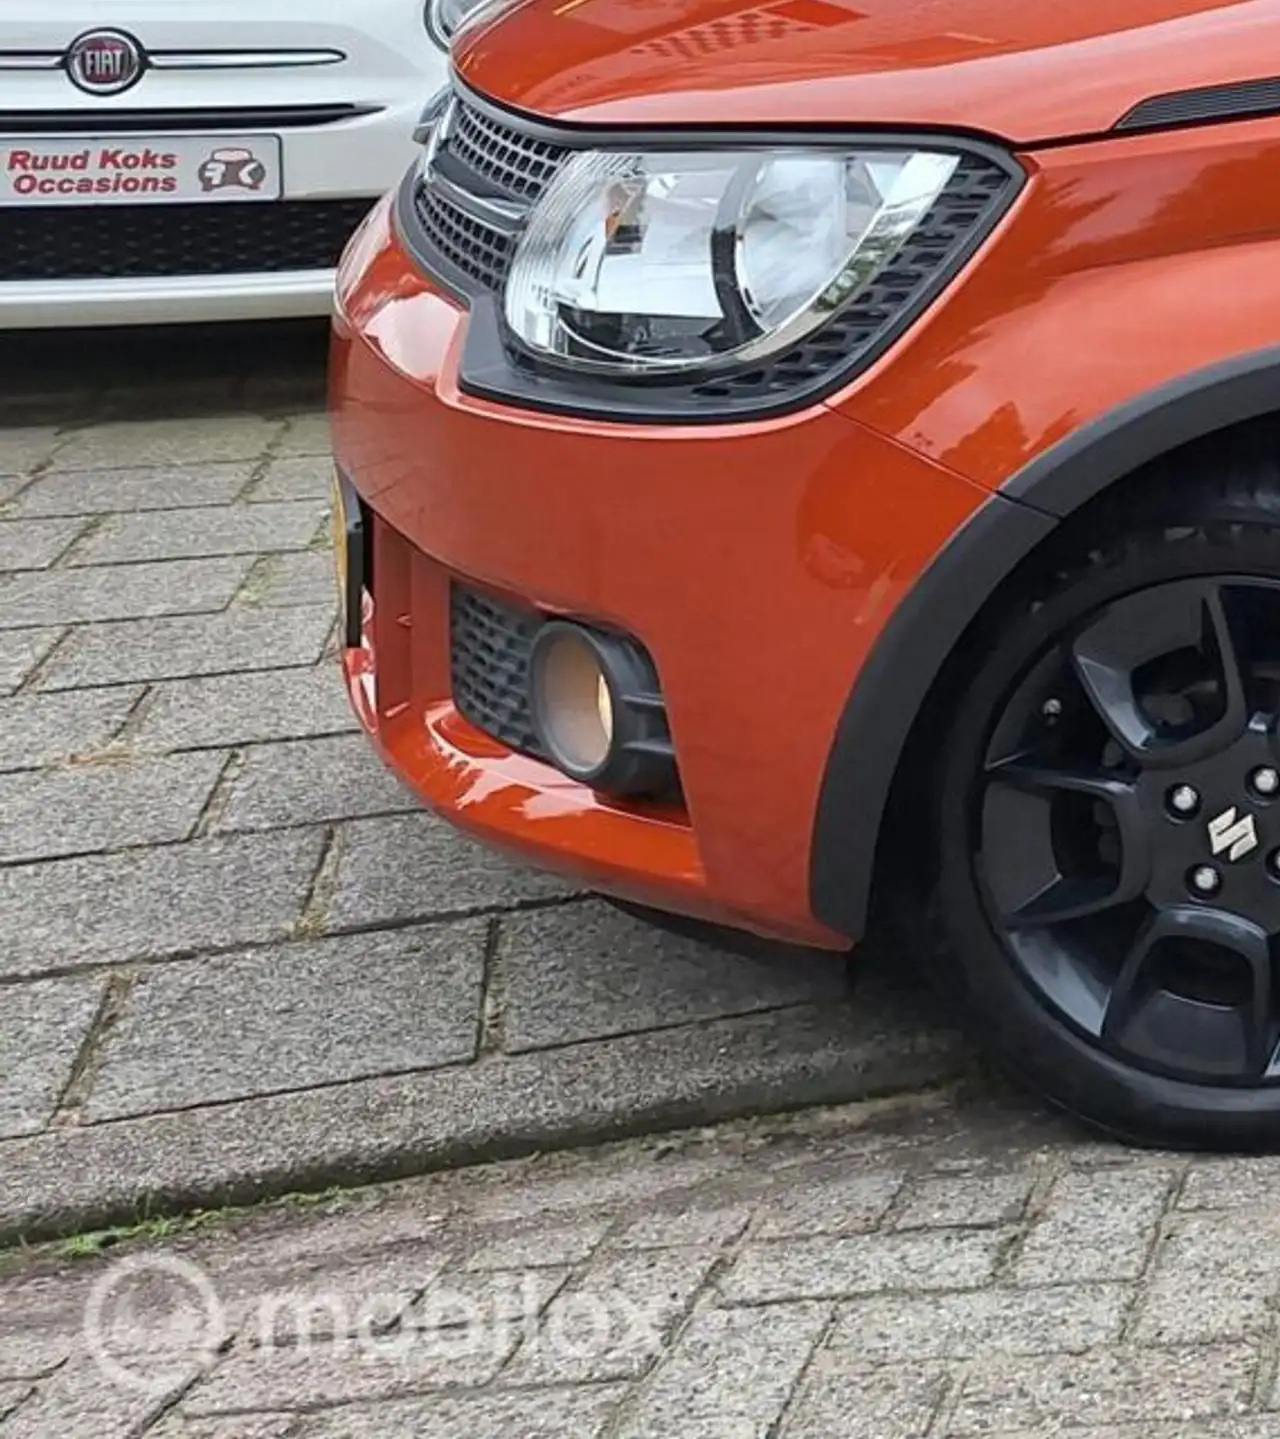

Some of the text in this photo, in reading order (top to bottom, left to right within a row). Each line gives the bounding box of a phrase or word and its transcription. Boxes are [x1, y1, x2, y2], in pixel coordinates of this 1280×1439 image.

[85, 49, 123, 76] FIAT
[7, 148, 177, 171] Ruud Koks
[13, 172, 177, 194] Occasions
